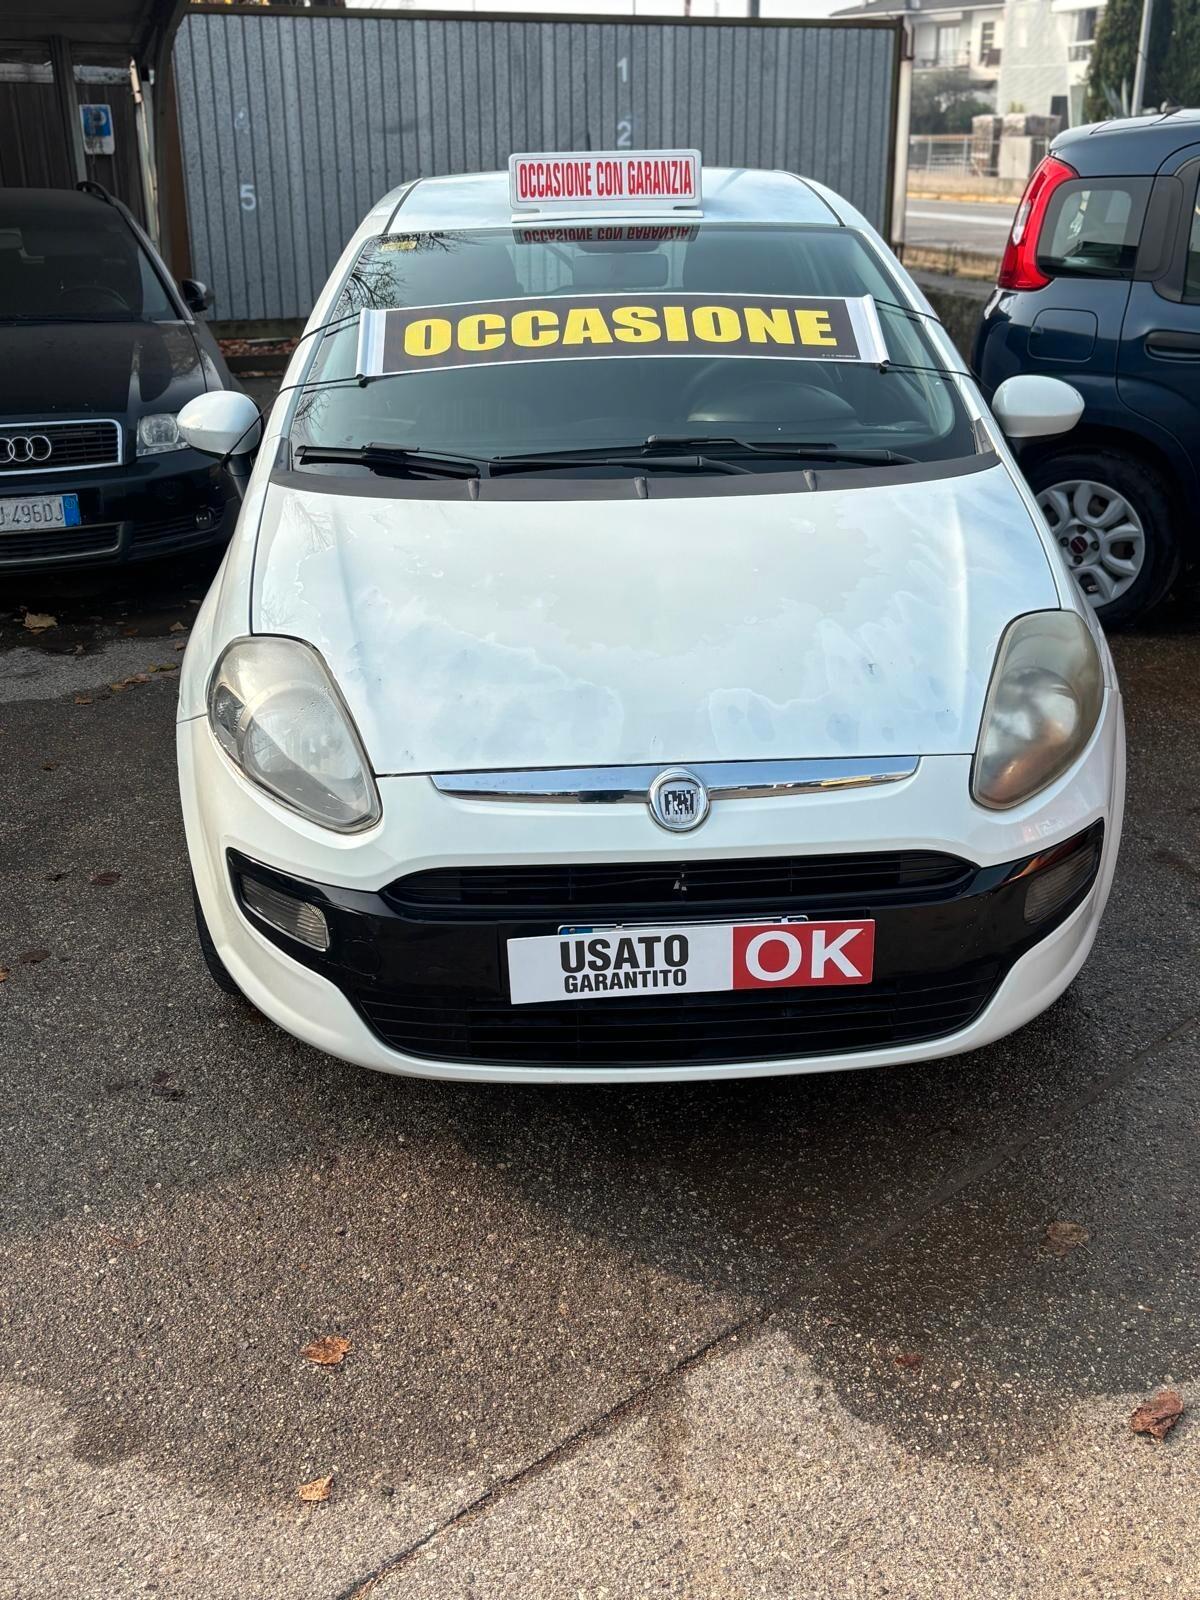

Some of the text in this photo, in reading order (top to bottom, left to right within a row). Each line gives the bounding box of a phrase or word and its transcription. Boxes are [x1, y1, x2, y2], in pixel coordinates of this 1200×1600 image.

[617, 59, 629, 82] 1
[88, 110, 108, 136] P
[617, 121, 632, 146] 2
[520, 161, 692, 198] OCCASIONE CON GARANZIA
[240, 184, 257, 211] 5
[404, 306, 838, 357] OCCASIONE
[560, 929, 863, 981] USATO OK
[564, 968, 687, 994] GARANTITO
